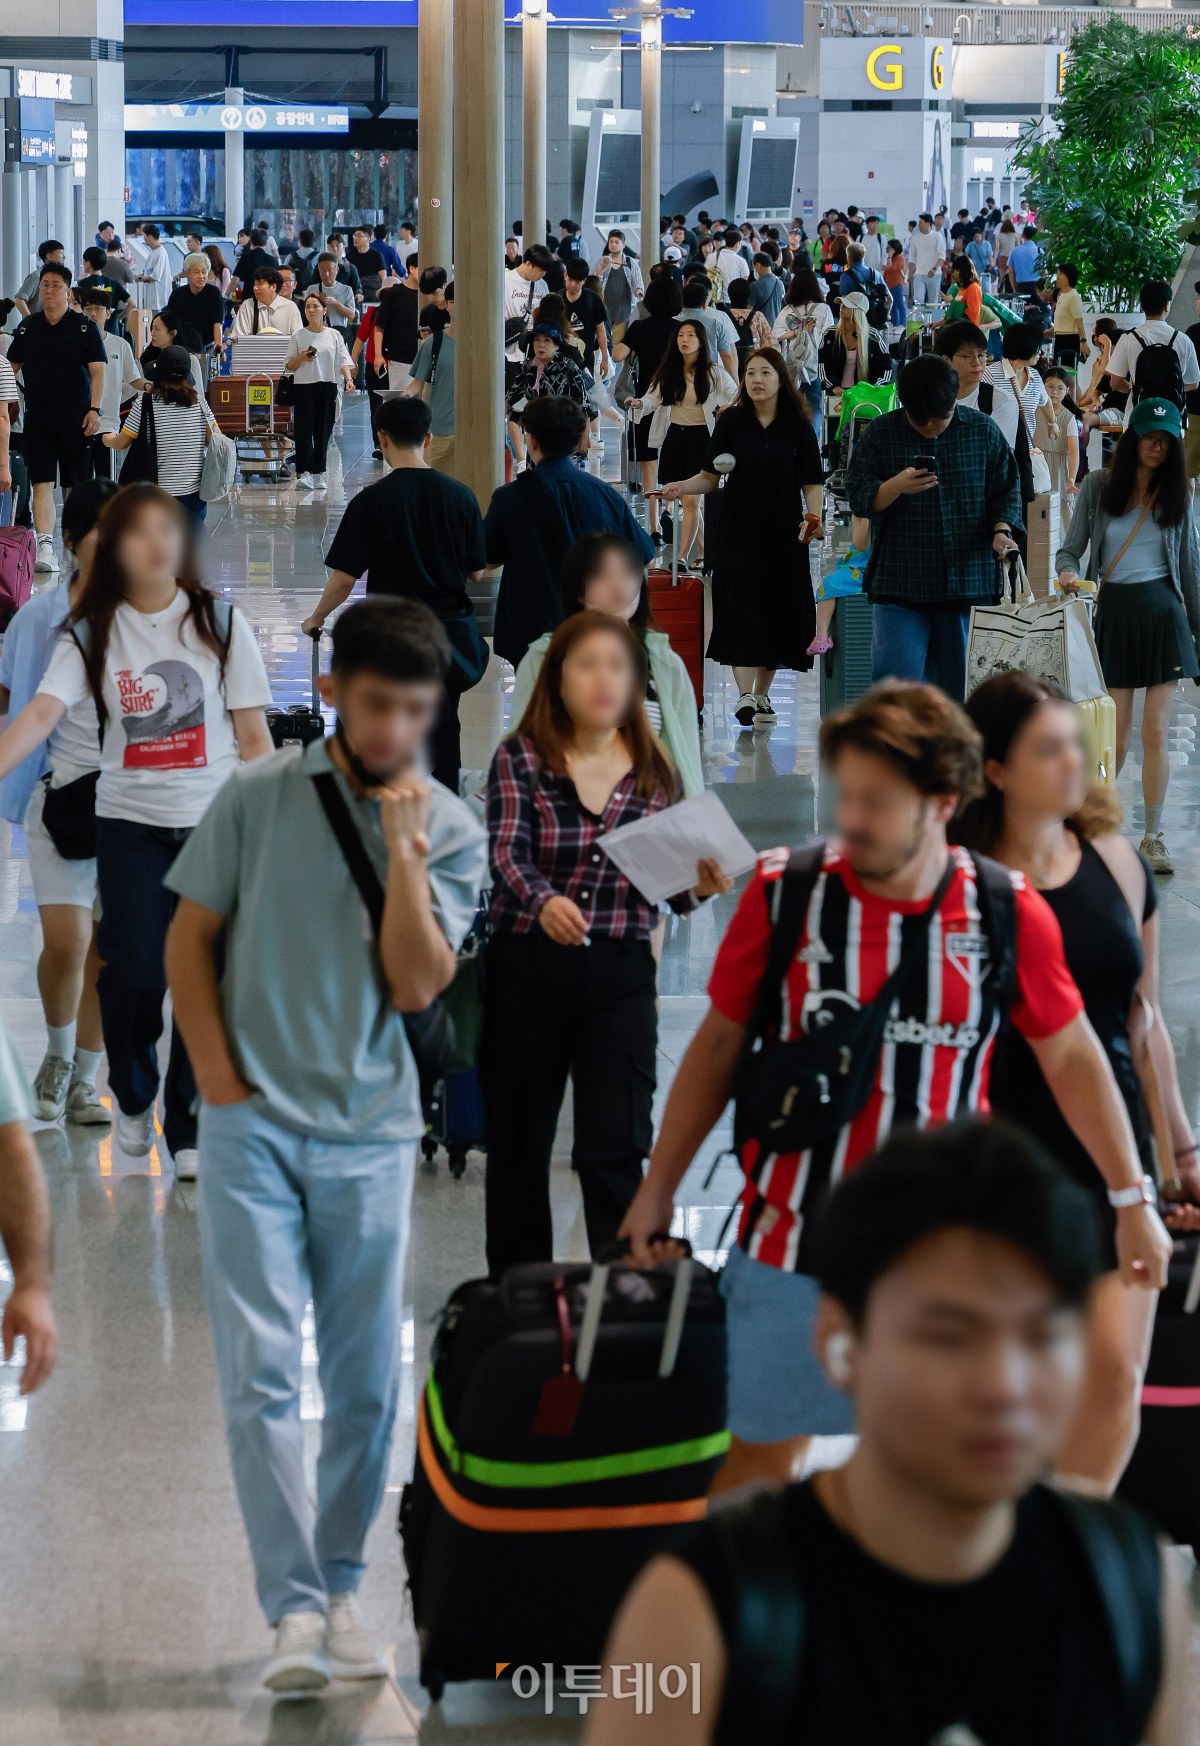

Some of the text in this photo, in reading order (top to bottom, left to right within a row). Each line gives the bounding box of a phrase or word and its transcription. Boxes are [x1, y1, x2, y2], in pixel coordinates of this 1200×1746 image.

[866, 44, 903, 91] G
[931, 44, 945, 91] G
[275, 111, 315, 126] 공항안내
[117, 676, 143, 697] BIG
